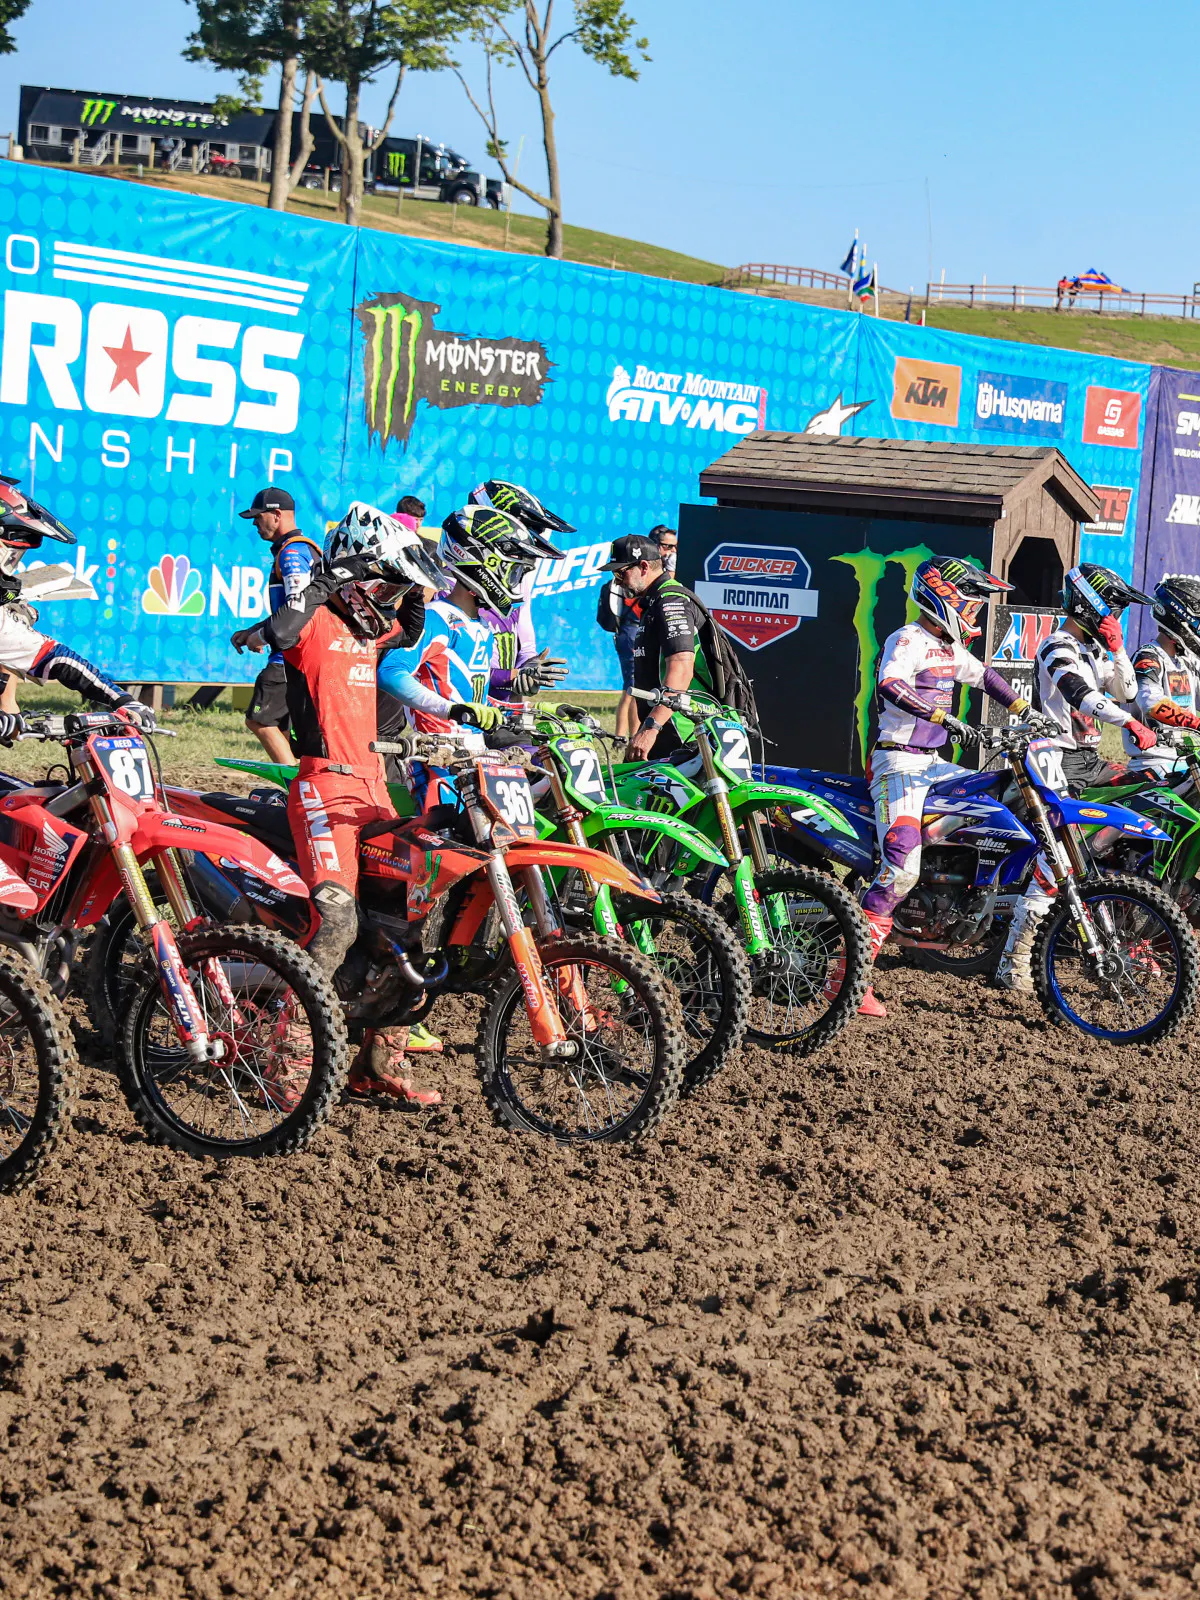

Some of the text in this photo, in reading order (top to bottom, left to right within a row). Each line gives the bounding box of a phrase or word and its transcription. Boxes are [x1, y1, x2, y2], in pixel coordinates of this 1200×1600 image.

[425, 338, 542, 380] MONSTER
[441, 379, 522, 398] ENERGY
[633, 365, 760, 403] ROCKY MOUNTAIN
[905, 376, 948, 408] KTM
[993, 389, 1064, 423] Husqvarna
[1174, 448, 1191, 458] WORLD
[453, 545, 466, 559] BELL
[537, 543, 613, 586] UFO
[718, 554, 797, 575] TUCKER
[532, 575, 602, 599] PLAST
[922, 571, 960, 608] 100%
[723, 588, 789, 610] IRONMAN
[1088, 592, 1105, 612] FOX
[721, 613, 789, 625] NATIONAL
[1169, 601, 1196, 624] OAKLEY
[348, 663, 376, 682] KTM
[1156, 704, 1194, 726] FXR
[113, 739, 132, 748] REED
[109, 748, 154, 797] 87
[634, 770, 690, 793] KX
[496, 780, 535, 825] 361
[776, 788, 821, 803] CIRCUIT
[1142, 790, 1184, 811] KX
[924, 798, 1004, 818] YZ
[161, 822, 206, 833] PROPANE
[607, 814, 686, 830] PRO CIRCUIT
[32, 855, 65, 869] SOUTHERN
[33, 846, 66, 862] HONDA
[833, 844, 860, 861] GYTR
[28, 877, 51, 891] SLR
[741, 879, 764, 941] DUNLOP
